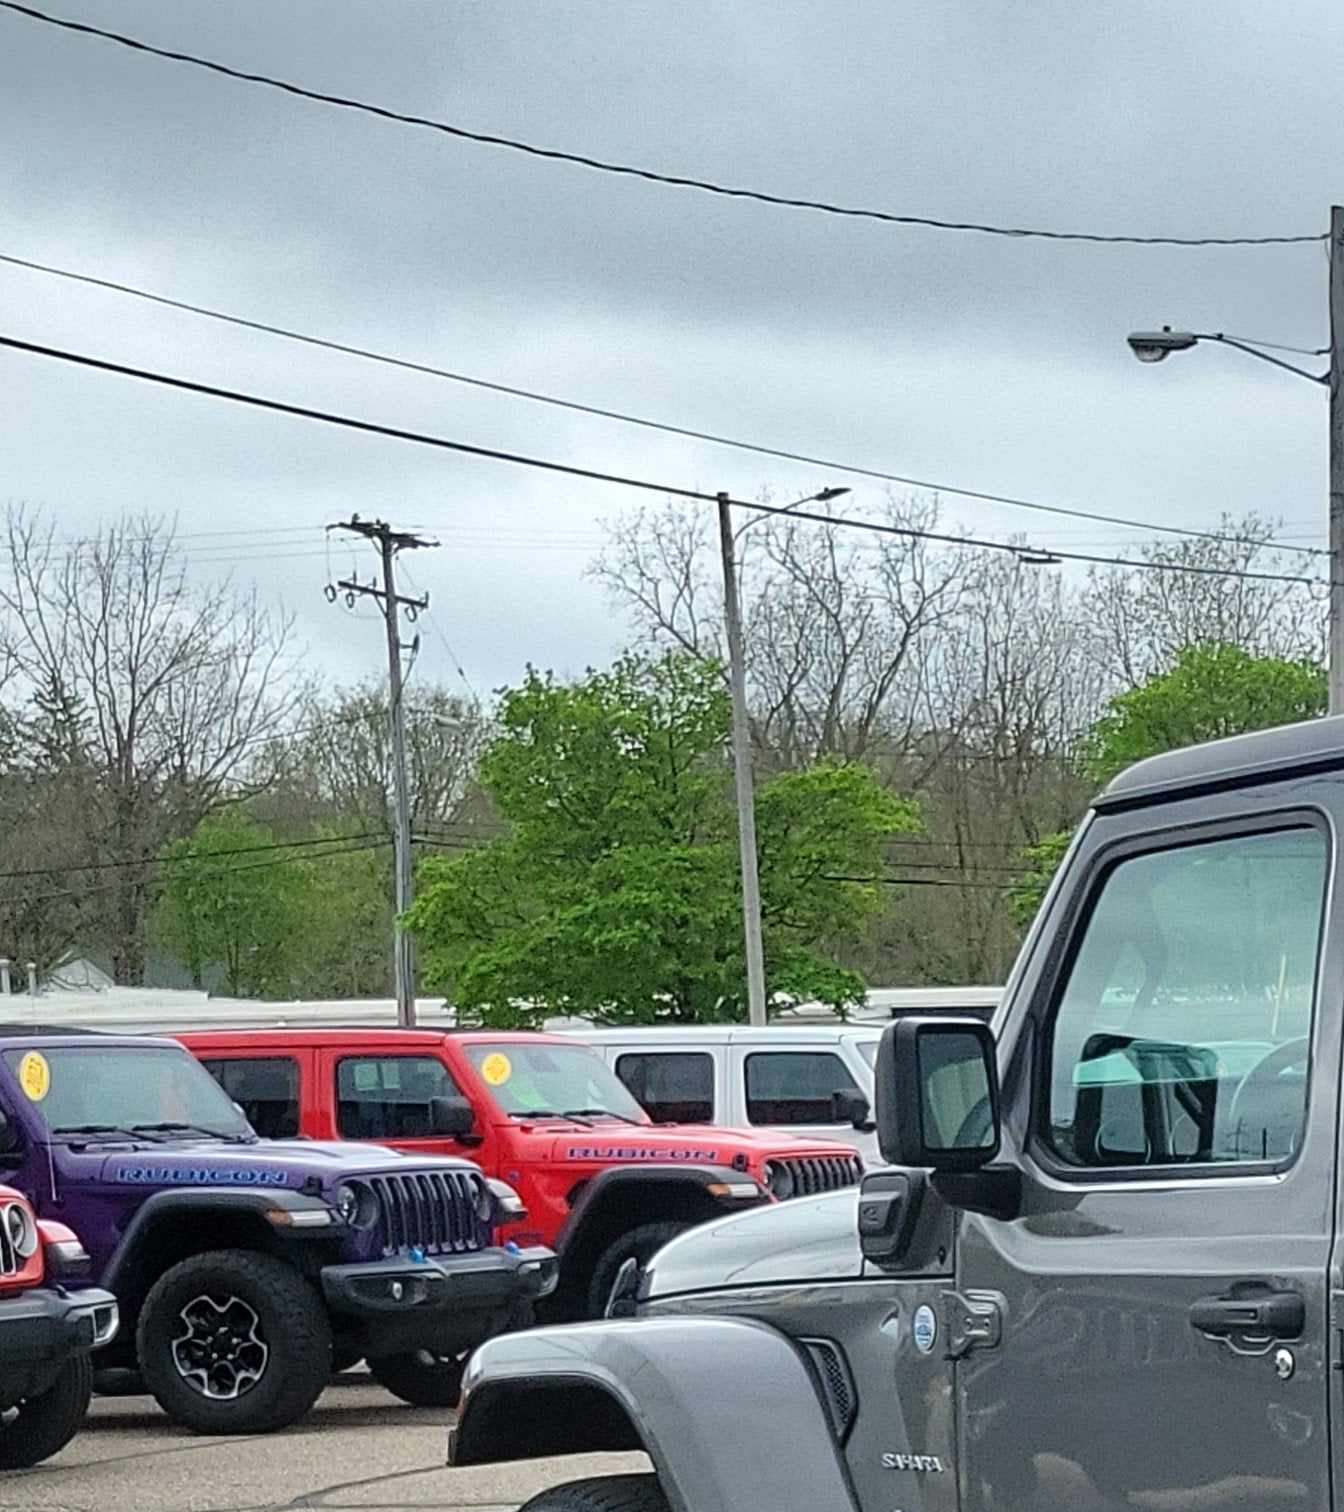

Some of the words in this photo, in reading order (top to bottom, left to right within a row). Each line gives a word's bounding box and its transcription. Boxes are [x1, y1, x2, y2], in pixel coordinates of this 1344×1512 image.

[567, 1145, 719, 1163] RUBICON
[117, 1165, 288, 1185] RUBICON
[881, 1452, 945, 1473] SAHARA
